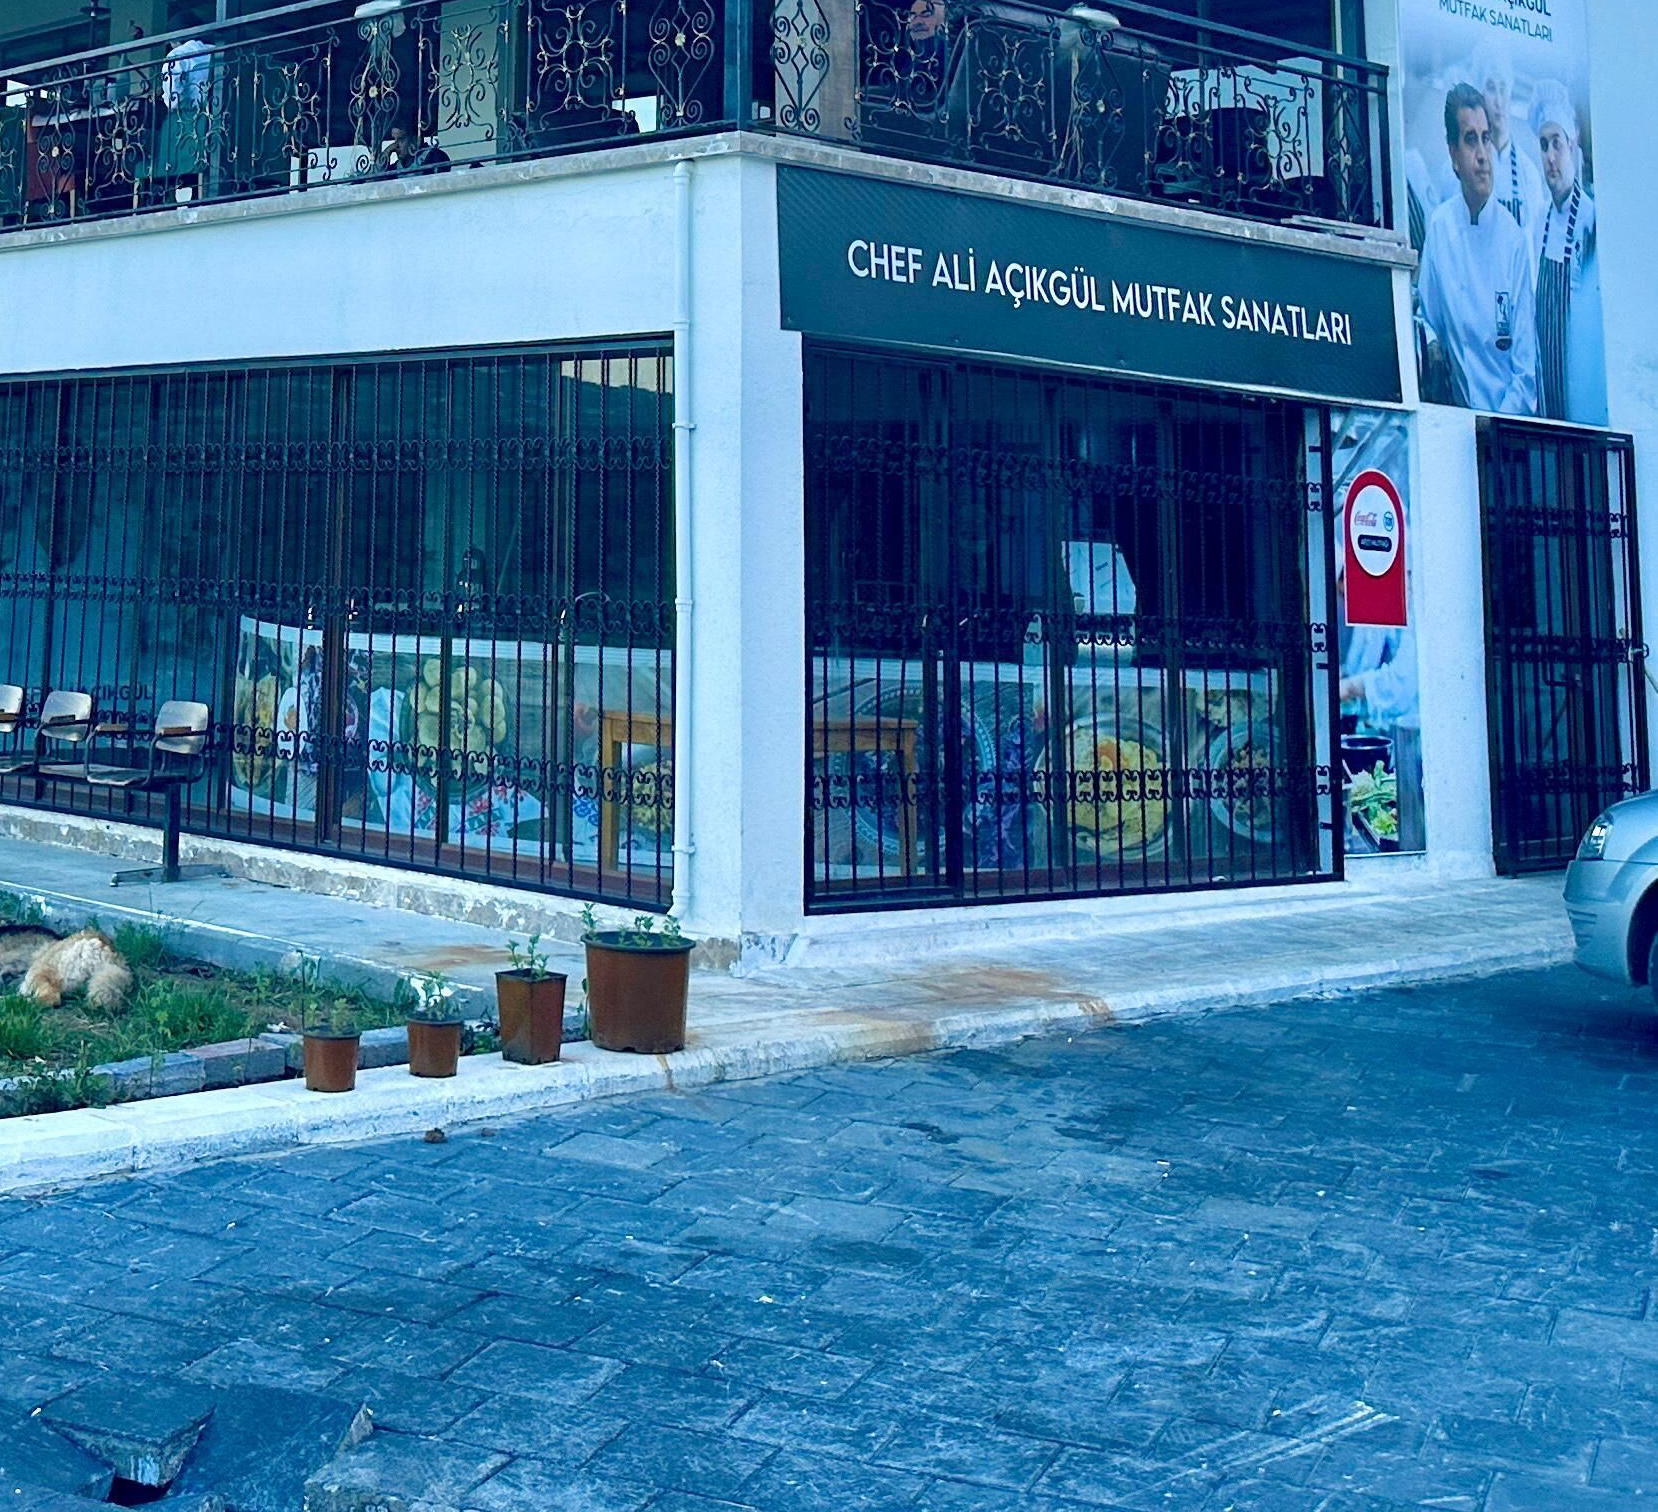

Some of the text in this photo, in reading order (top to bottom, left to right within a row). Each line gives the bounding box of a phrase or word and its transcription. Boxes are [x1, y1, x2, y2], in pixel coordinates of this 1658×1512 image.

[1489, 9, 1553, 42] SANATLARI
[847, 239, 1352, 345] CHEF ALİ AÇIKGÜL MUTFAK SANATLARI
